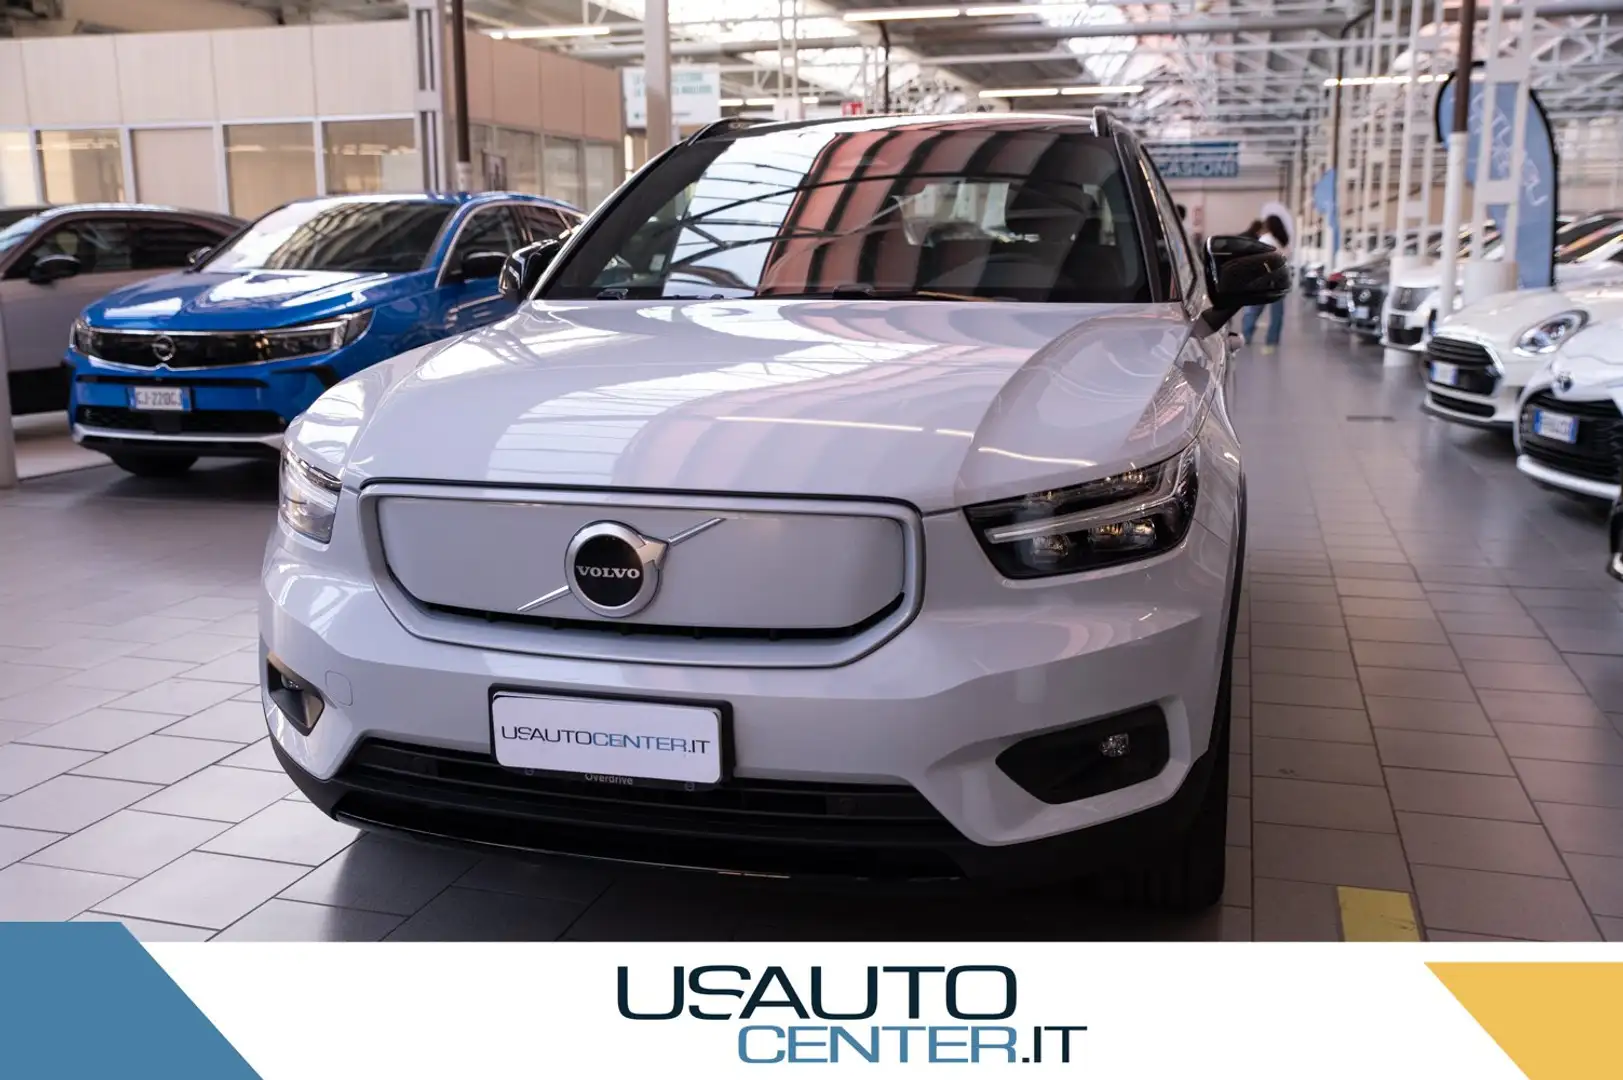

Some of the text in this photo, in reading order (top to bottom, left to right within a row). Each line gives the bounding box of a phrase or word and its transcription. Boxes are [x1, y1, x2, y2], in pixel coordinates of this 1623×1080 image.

[576, 565, 640, 579] VOLVO
[501, 726, 711, 754] USAUTOCENTER.IT
[584, 772, 633, 786] Overdrive
